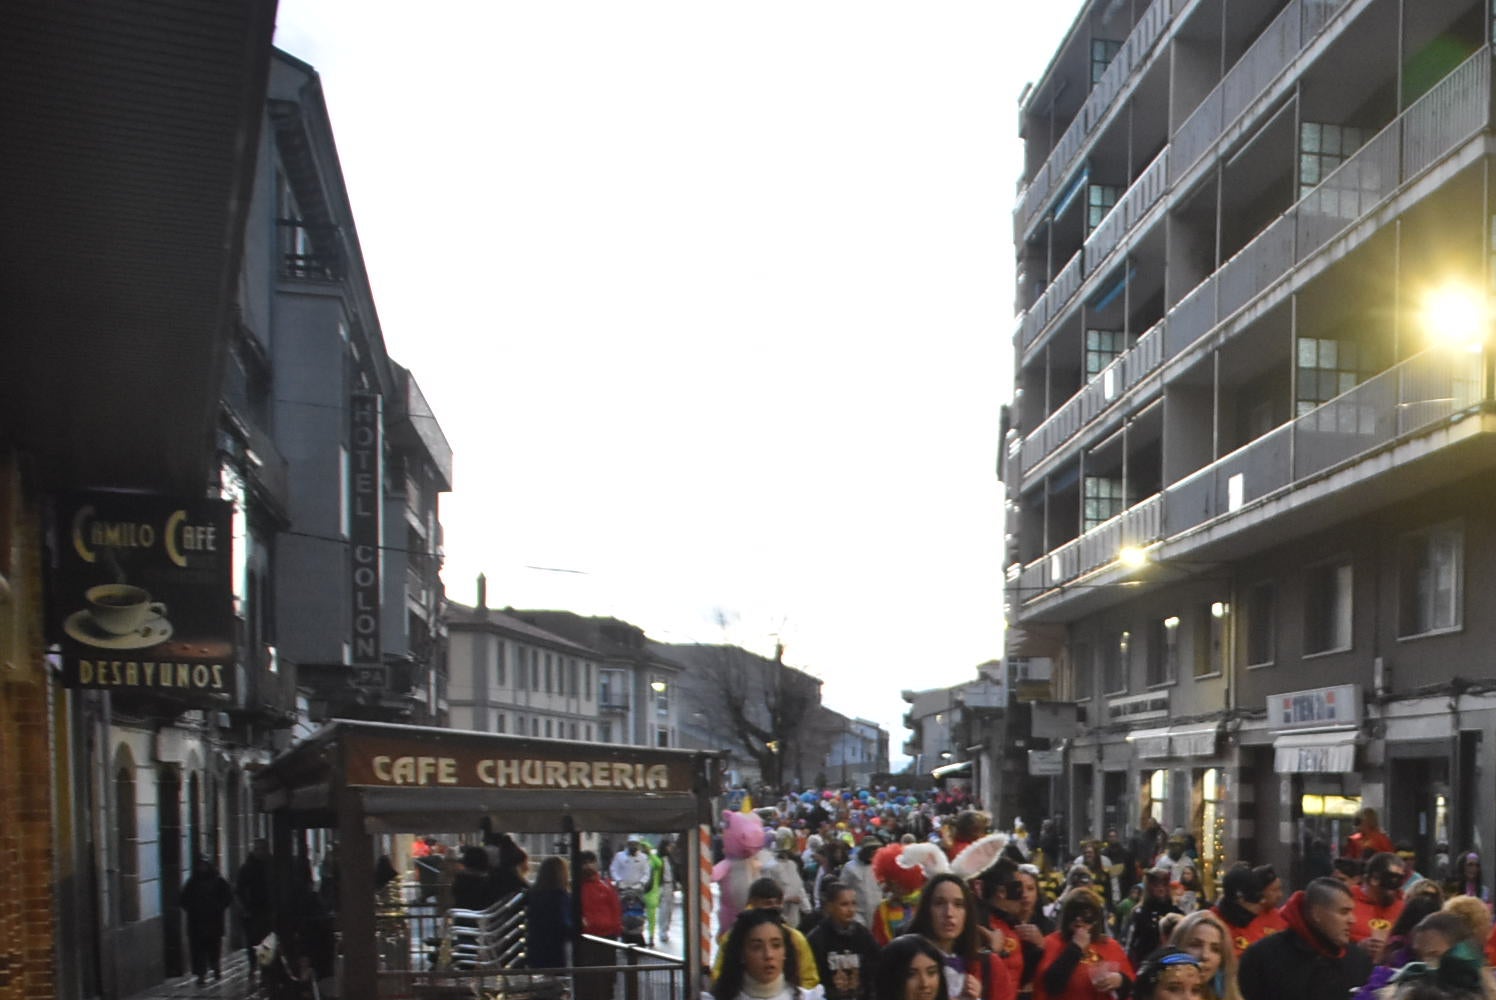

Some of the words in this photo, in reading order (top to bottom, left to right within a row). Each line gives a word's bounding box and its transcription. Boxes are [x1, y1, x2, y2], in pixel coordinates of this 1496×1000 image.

[354, 403, 374, 516] HOTEL
[355, 545, 375, 657] COLON
[80, 659, 223, 689] DESAYUNOS
[372, 756, 459, 785] CAFE
[476, 759, 669, 790] CHURRERIA
